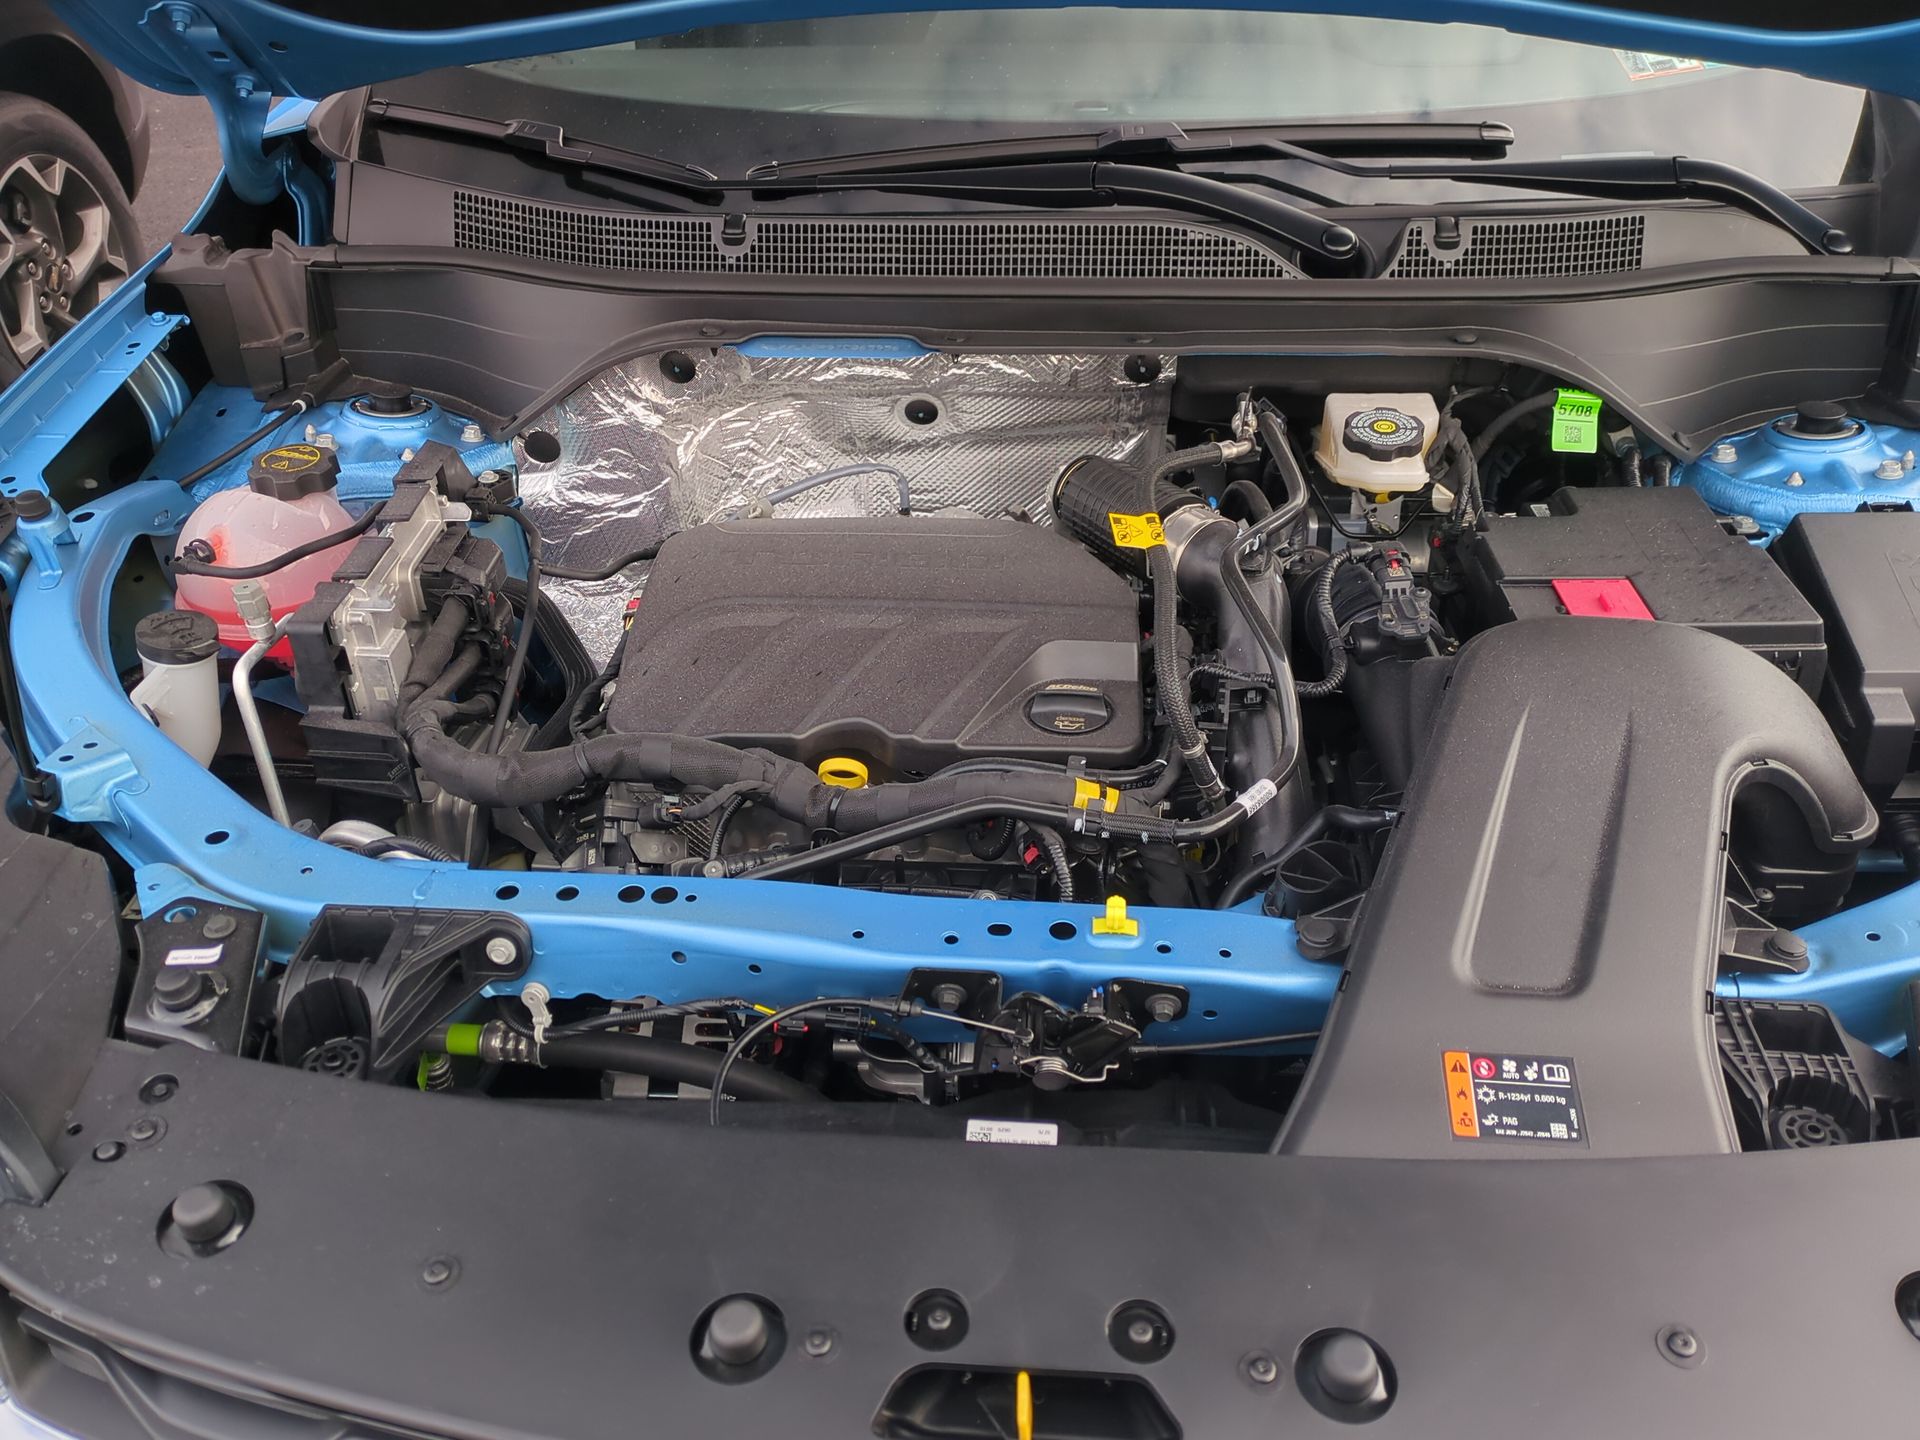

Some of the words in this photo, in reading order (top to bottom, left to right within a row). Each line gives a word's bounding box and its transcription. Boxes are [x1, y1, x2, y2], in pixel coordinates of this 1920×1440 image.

[1558, 404, 1593, 417] 5708
[1503, 1072, 1520, 1080] AUTO
[1498, 1092, 1531, 1103] R-1234yf
[1556, 1096, 1566, 1105] kg
[1502, 1116, 1519, 1126] PAG
